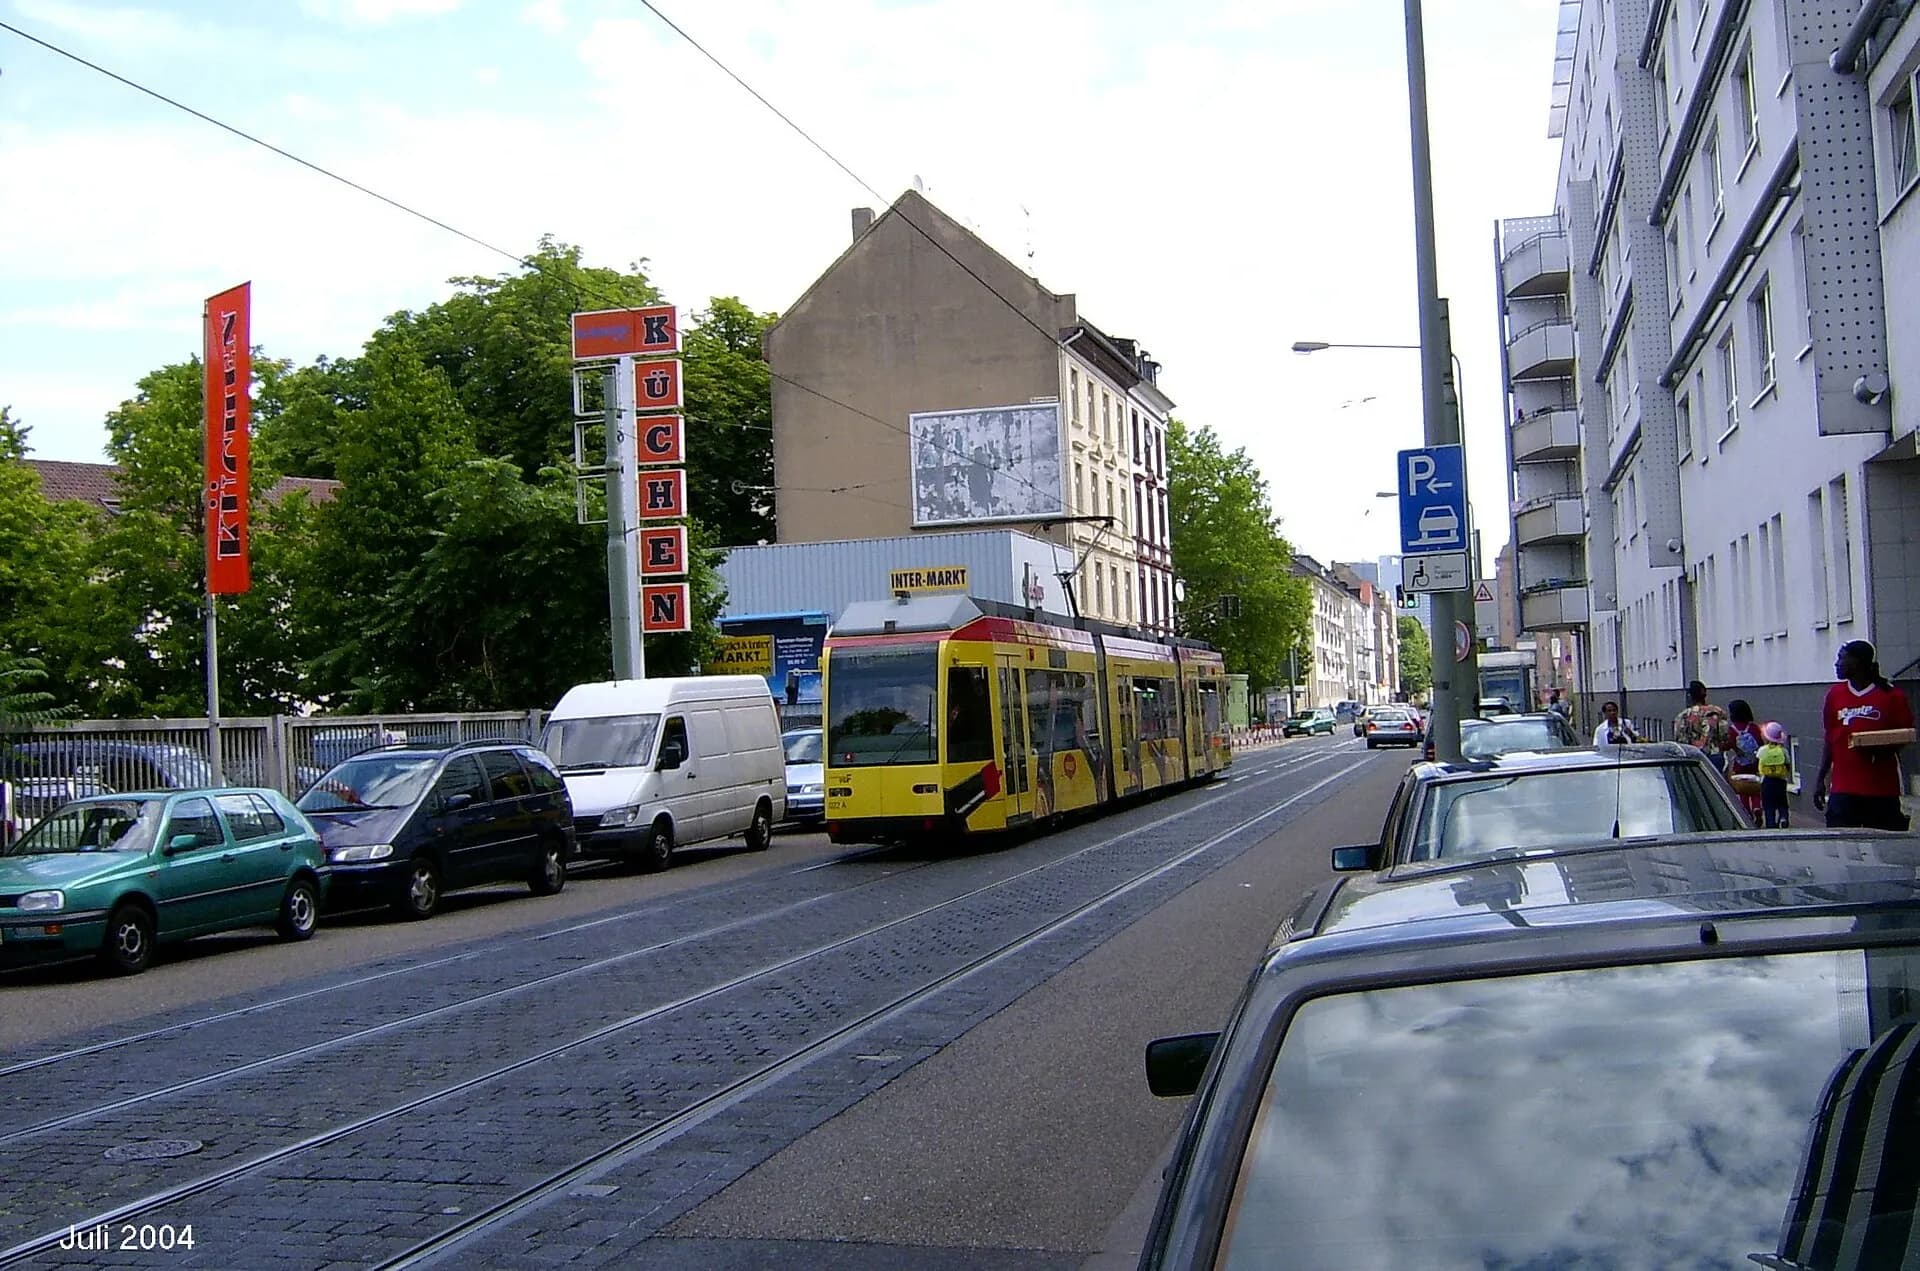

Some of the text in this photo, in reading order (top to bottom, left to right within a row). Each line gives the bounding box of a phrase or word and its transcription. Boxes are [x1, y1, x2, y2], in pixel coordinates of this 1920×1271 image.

[643, 315, 677, 623] KÜCHEN
[1408, 455, 1436, 496] P
[890, 569, 967, 589] INTER-MARKT
